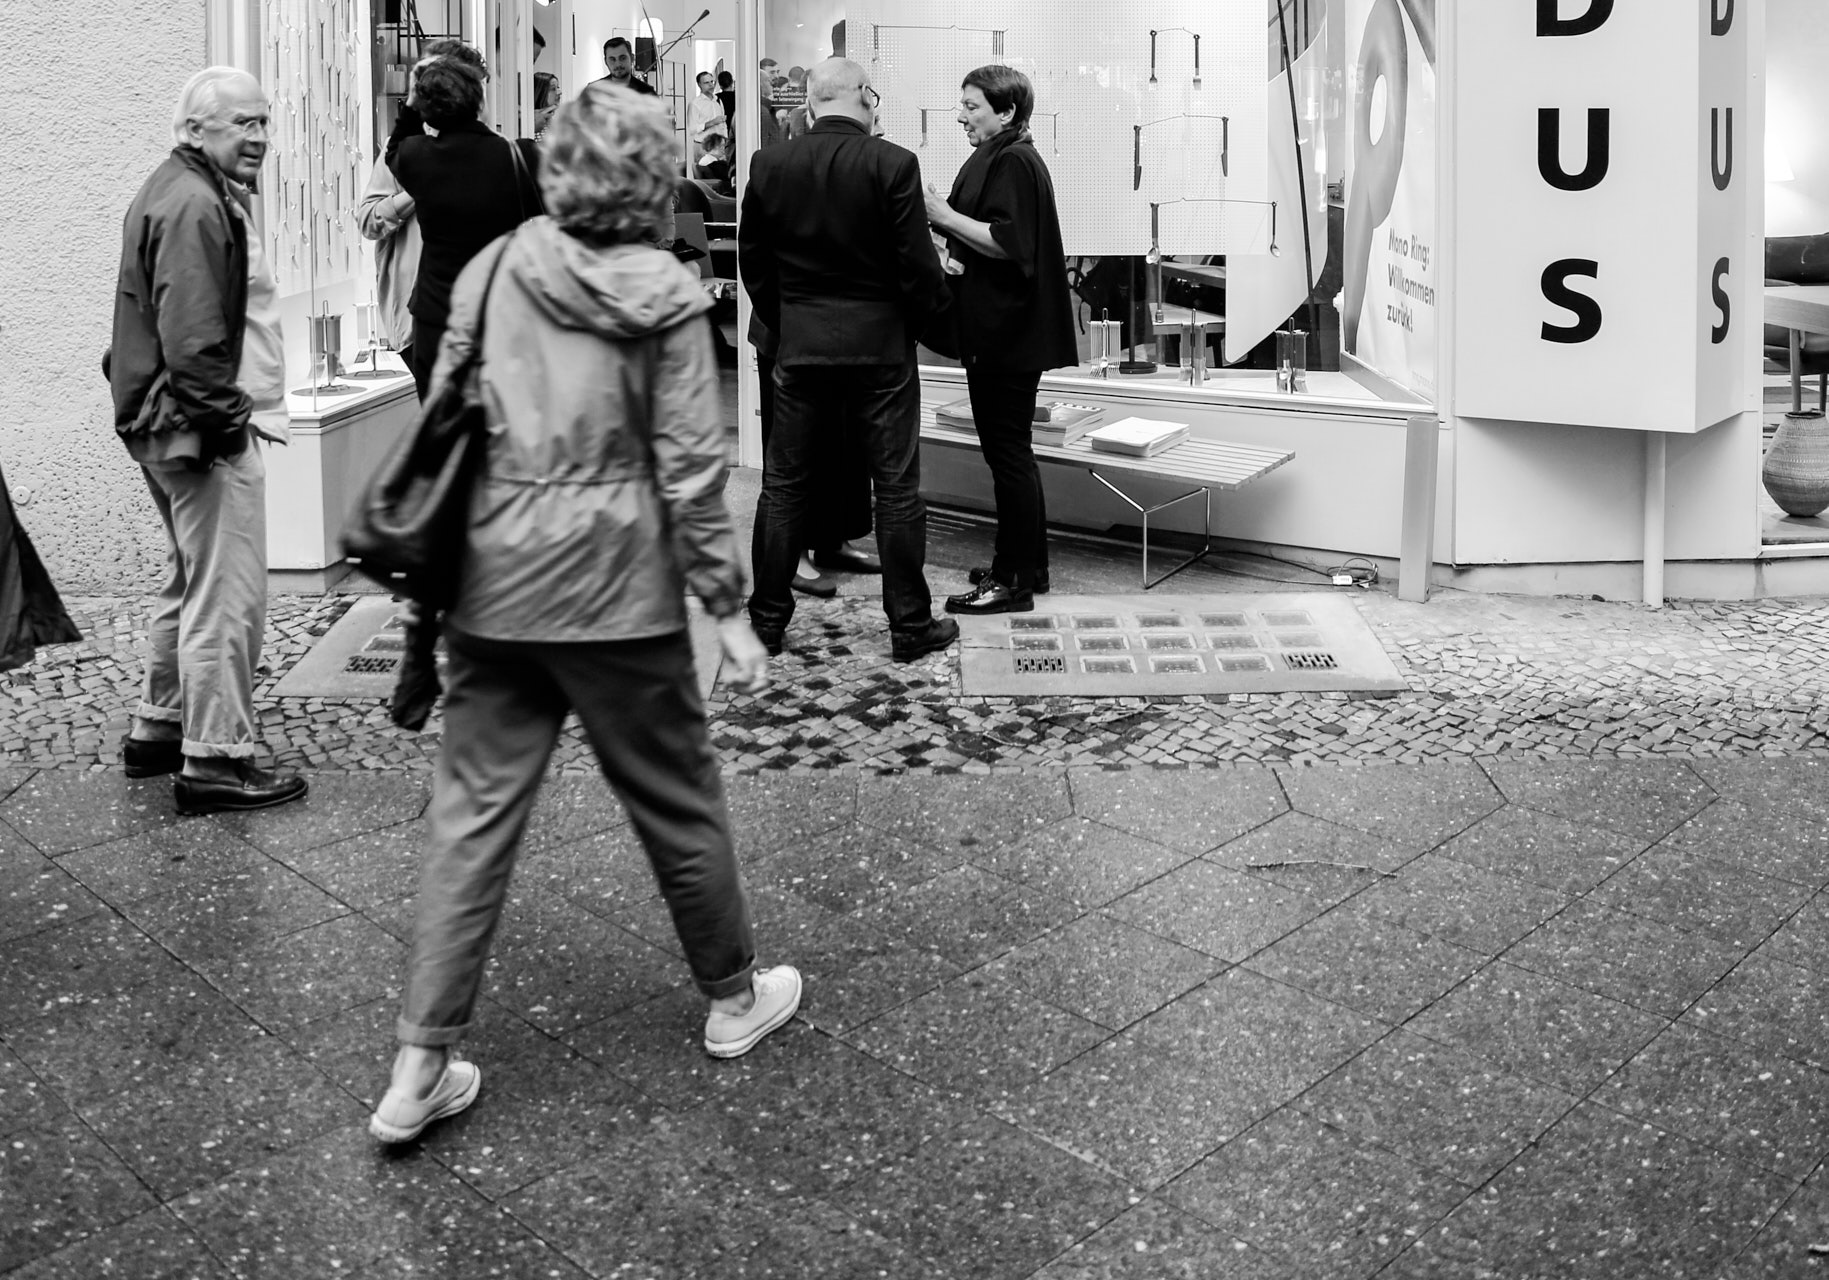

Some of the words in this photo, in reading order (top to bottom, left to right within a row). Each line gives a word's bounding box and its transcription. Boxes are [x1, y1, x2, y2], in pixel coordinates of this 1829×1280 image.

[1388, 227, 1409, 257] Mono
[1410, 234, 1430, 272] Ring:
[1387, 263, 1435, 307] Willkommen
[1386, 301, 1413, 334] zurück!
